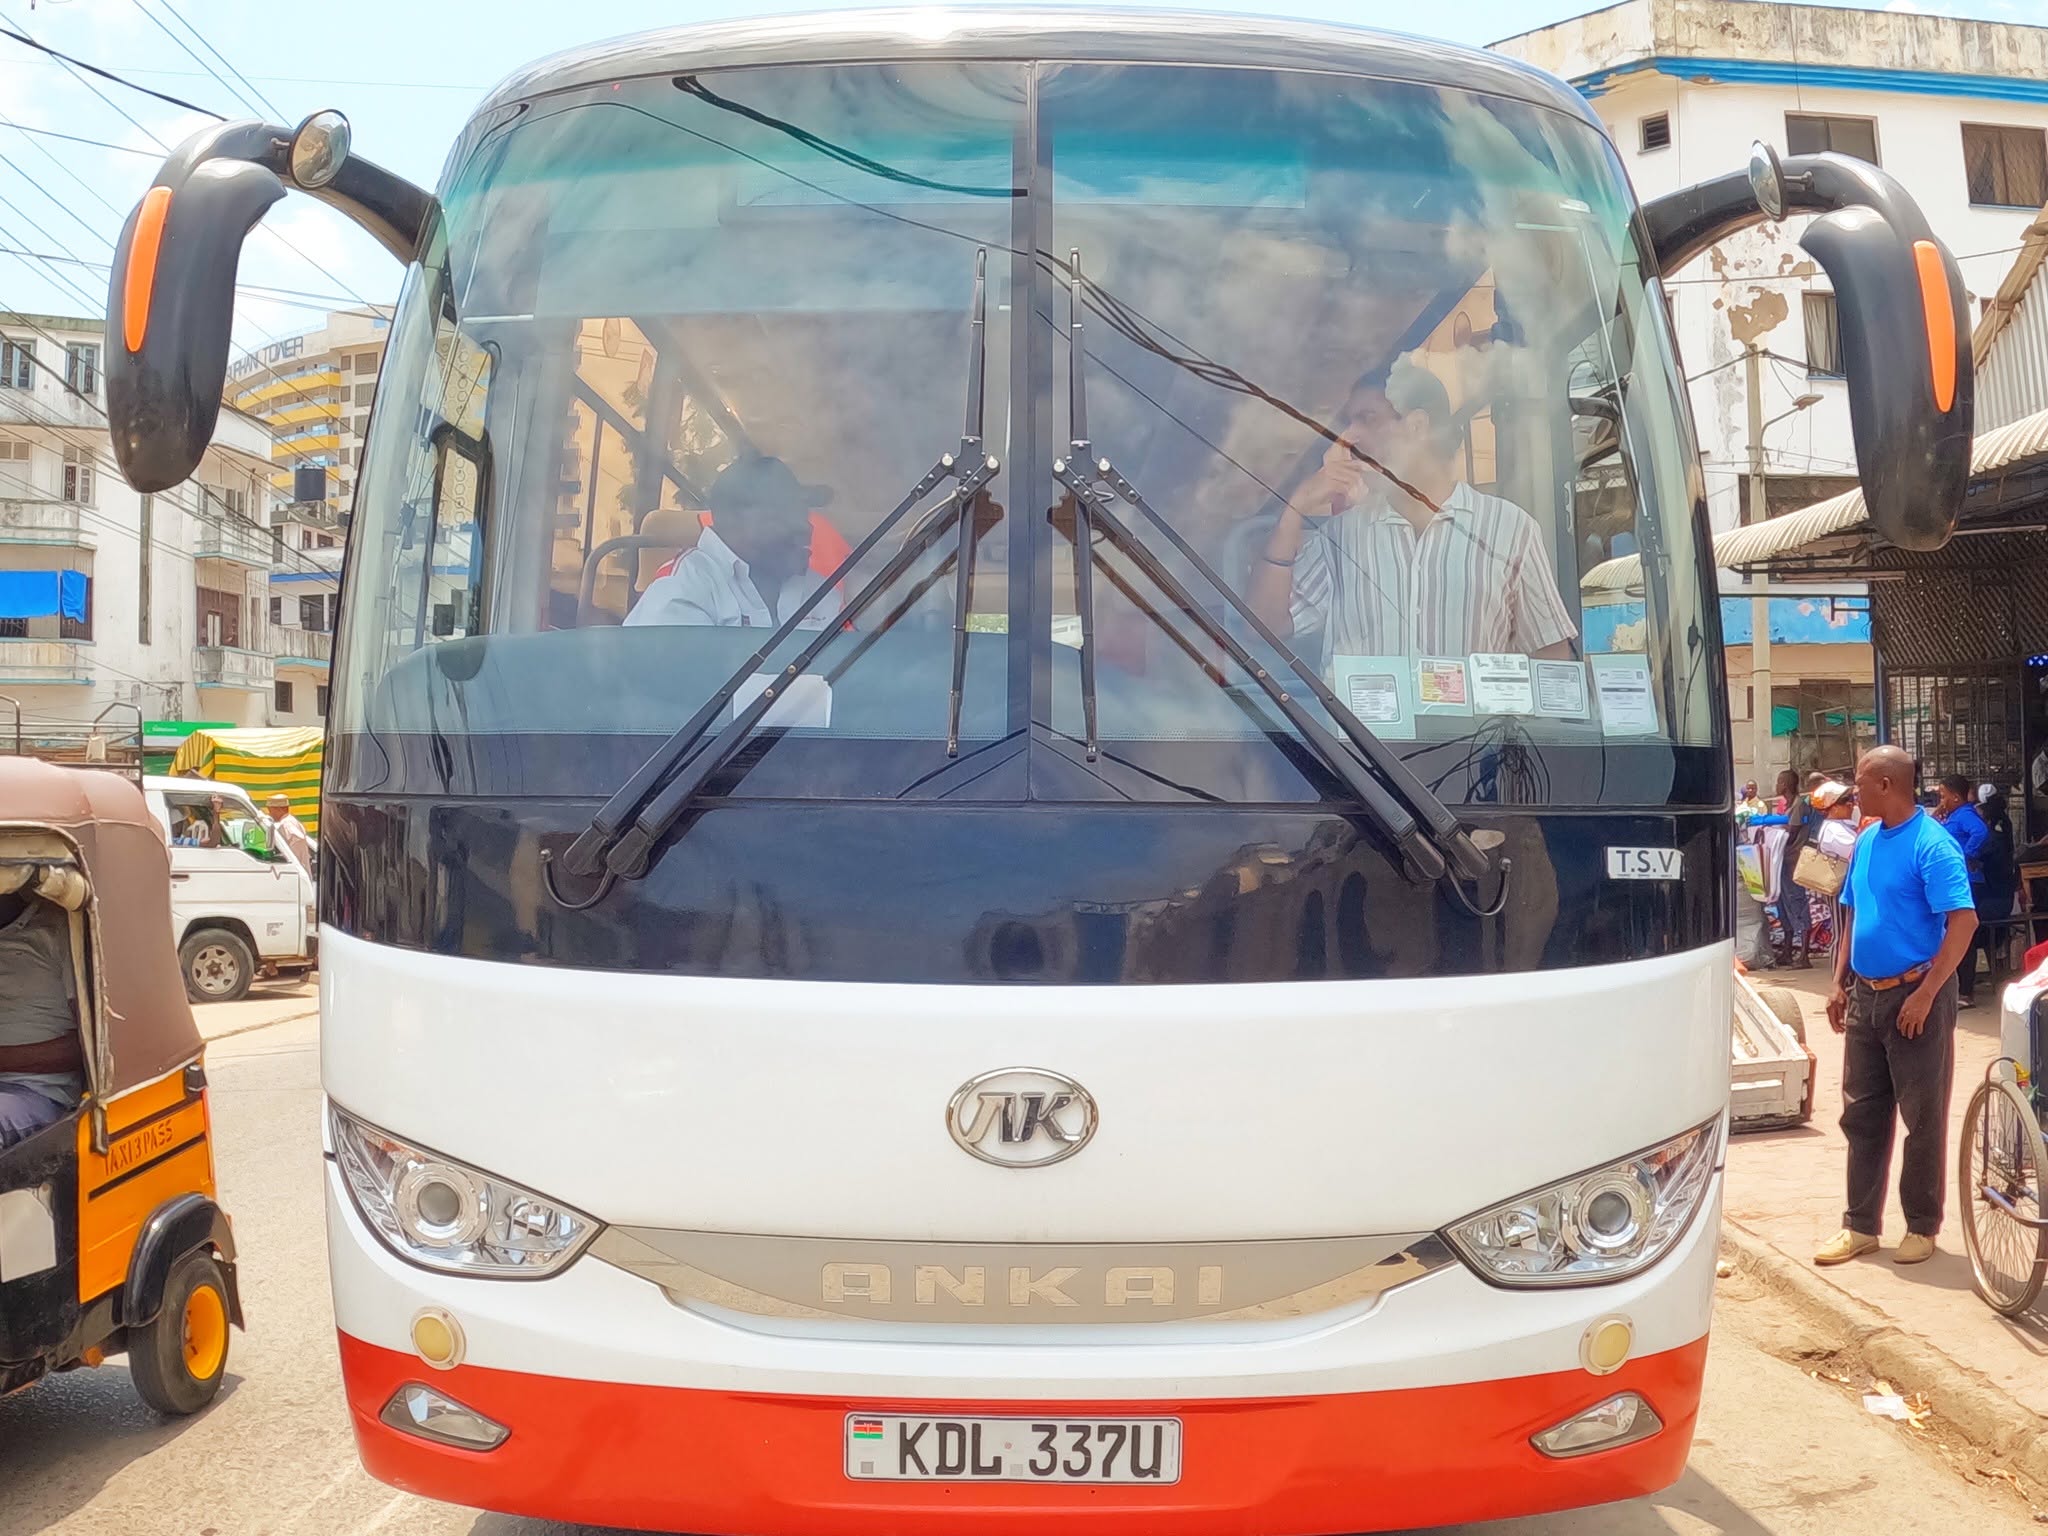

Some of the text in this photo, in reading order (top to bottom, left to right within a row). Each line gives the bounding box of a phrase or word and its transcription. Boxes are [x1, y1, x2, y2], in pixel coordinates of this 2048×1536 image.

[1615, 850, 1674, 873] T.S.V
[135, 1137, 142, 1160] 3
[144, 1119, 173, 1154] PASS
[820, 1262, 1224, 1307] ANKAI
[899, 1421, 1003, 1476] KDL
[1028, 1423, 1162, 1478] 337U
